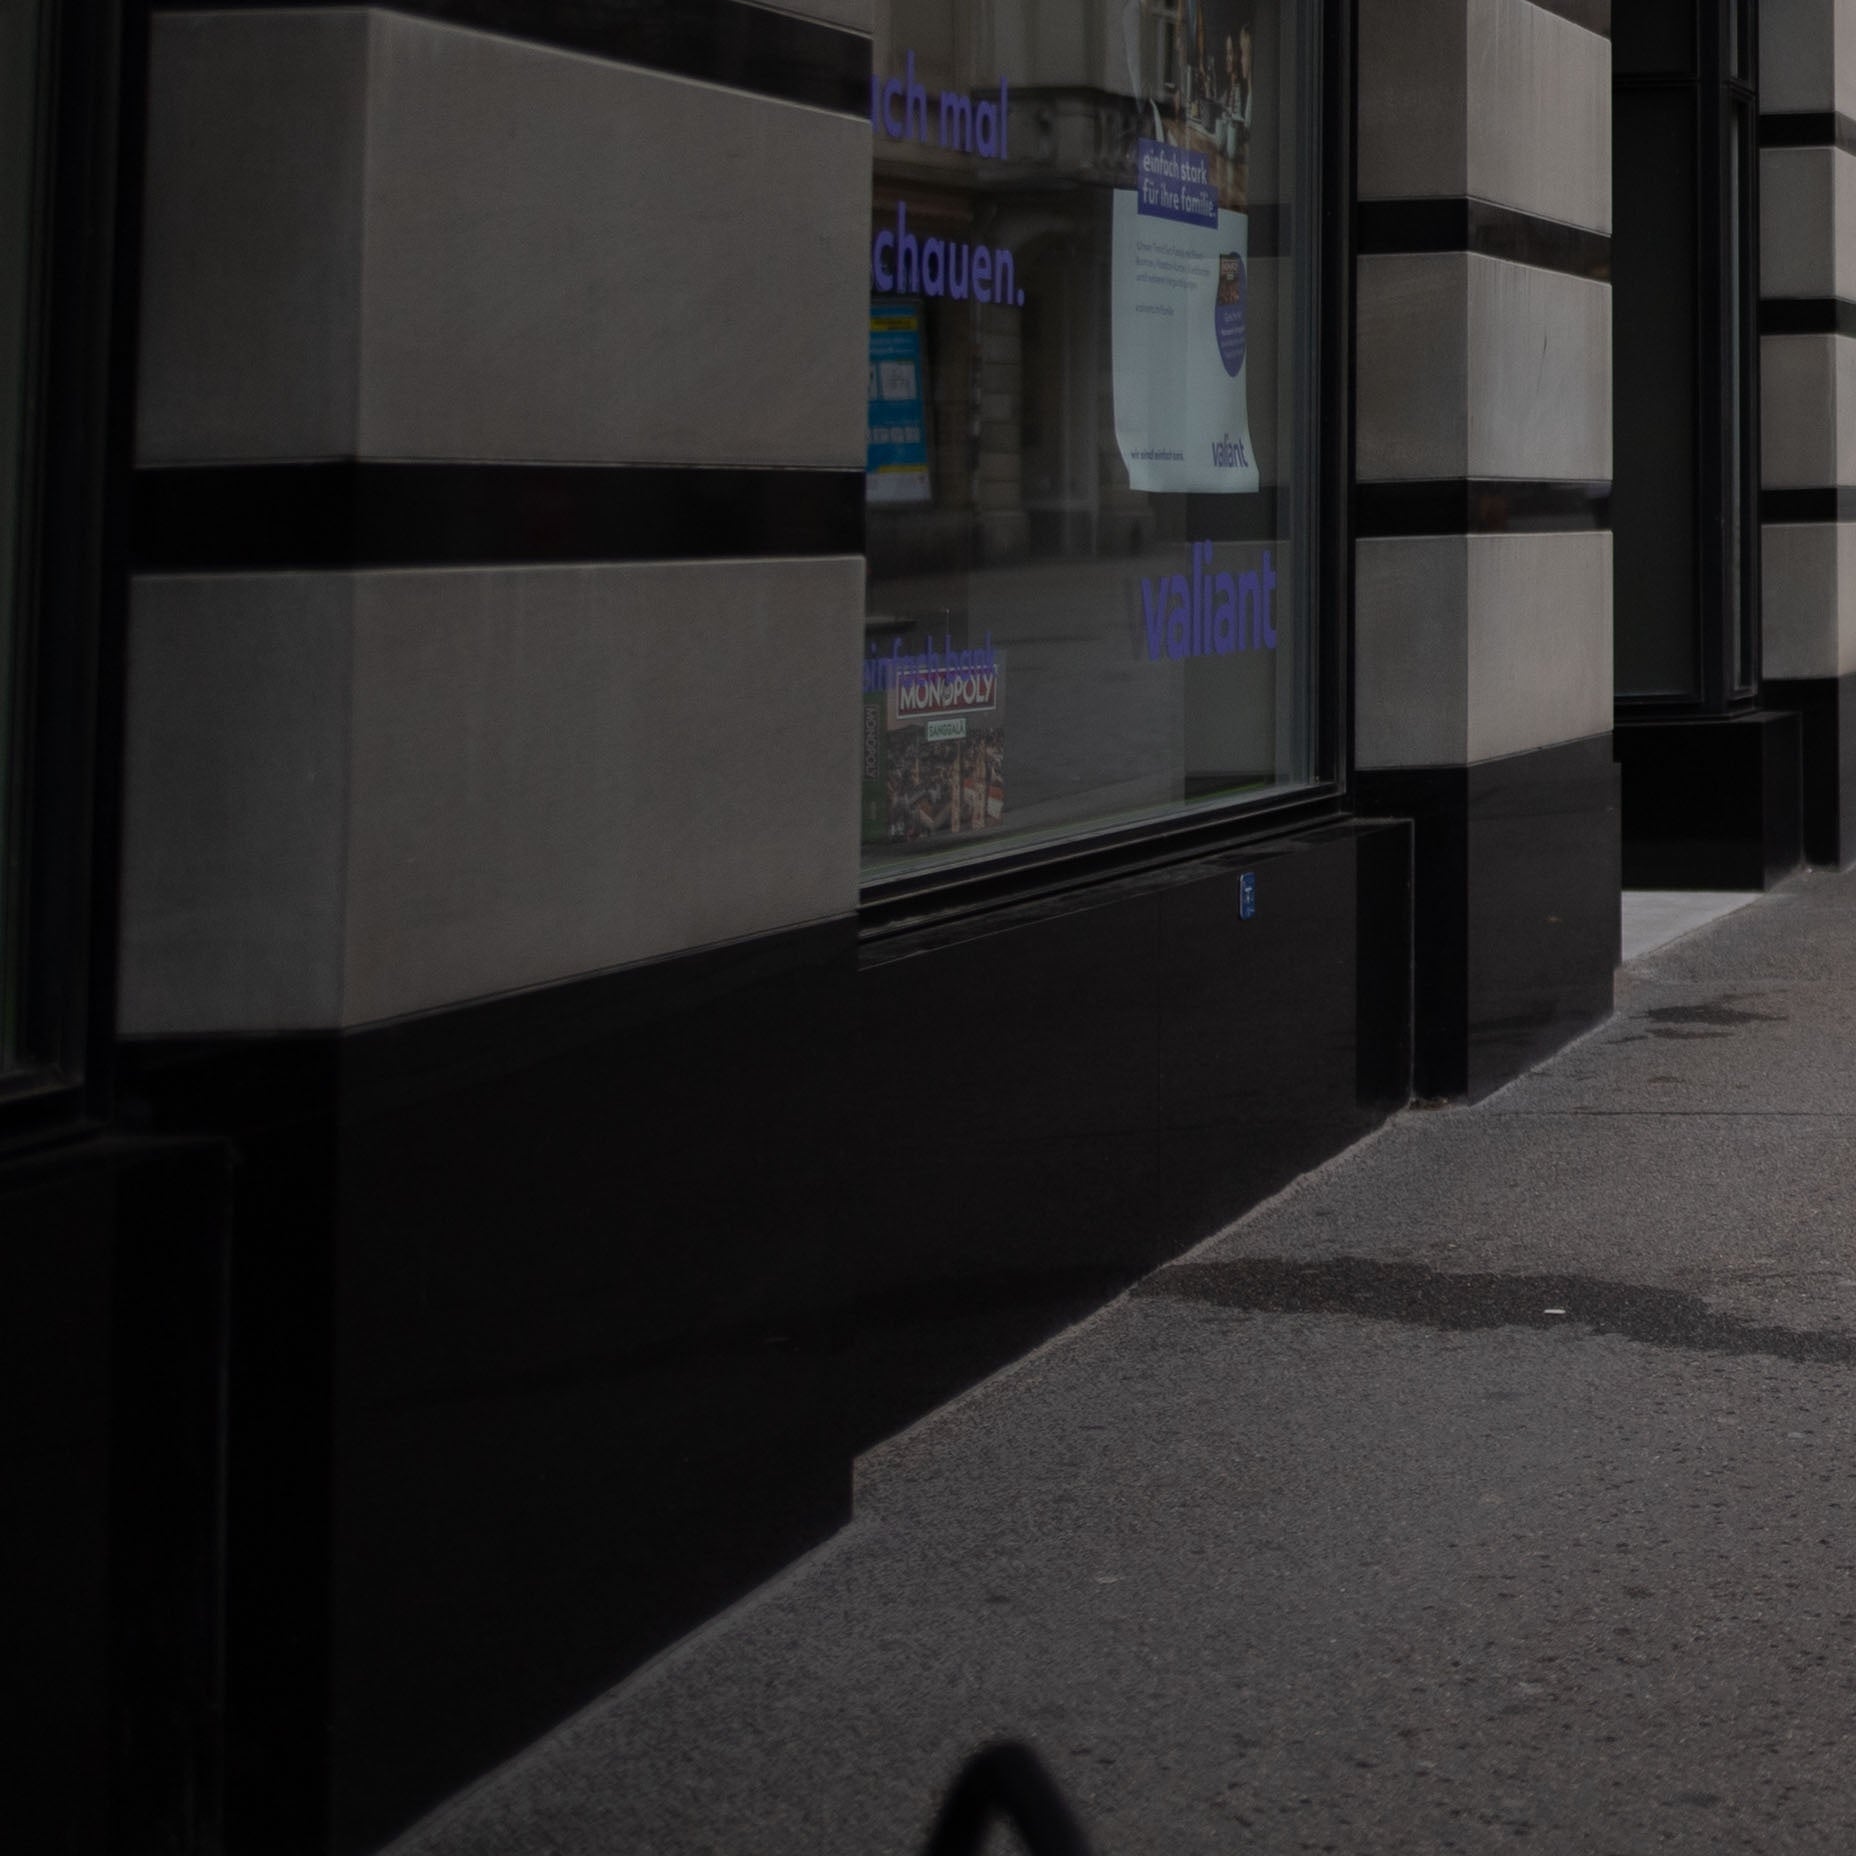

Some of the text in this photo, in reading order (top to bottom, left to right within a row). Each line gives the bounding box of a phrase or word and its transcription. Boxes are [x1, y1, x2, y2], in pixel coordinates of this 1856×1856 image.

[939, 74, 1008, 160] mal
[1143, 149, 1208, 185] einfach stark
[1143, 178, 1160, 204] für
[1161, 184, 1179, 210] ihre
[873, 200, 1026, 307] chauen.
[1212, 433, 1249, 468] valiant
[1140, 538, 1278, 662] valiant
[899, 673, 994, 710] MONOPOLY
